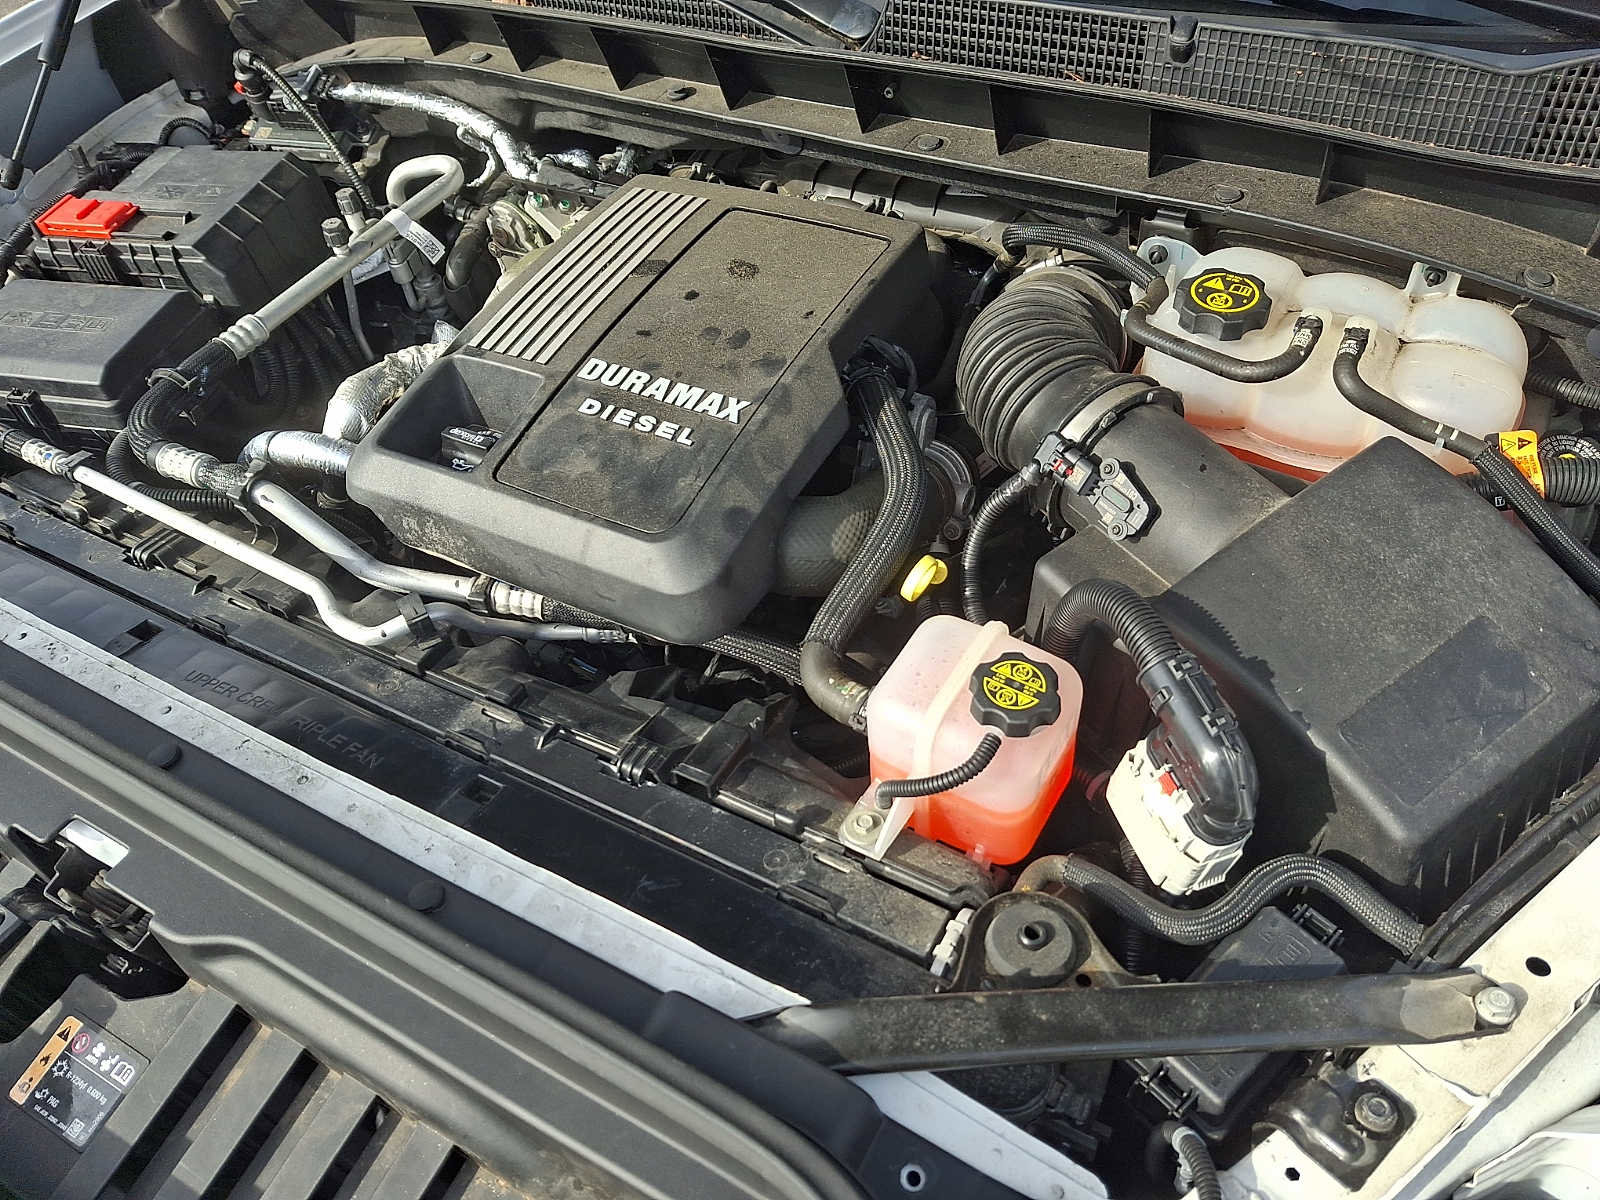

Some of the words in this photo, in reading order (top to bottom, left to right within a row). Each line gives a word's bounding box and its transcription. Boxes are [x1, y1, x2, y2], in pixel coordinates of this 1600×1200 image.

[576, 358, 752, 424] DURAMAX
[577, 398, 695, 446] DIESEL
[185, 669, 240, 699] UPPER
[291, 713, 349, 749] RIPLE
[343, 742, 384, 768] FAN
